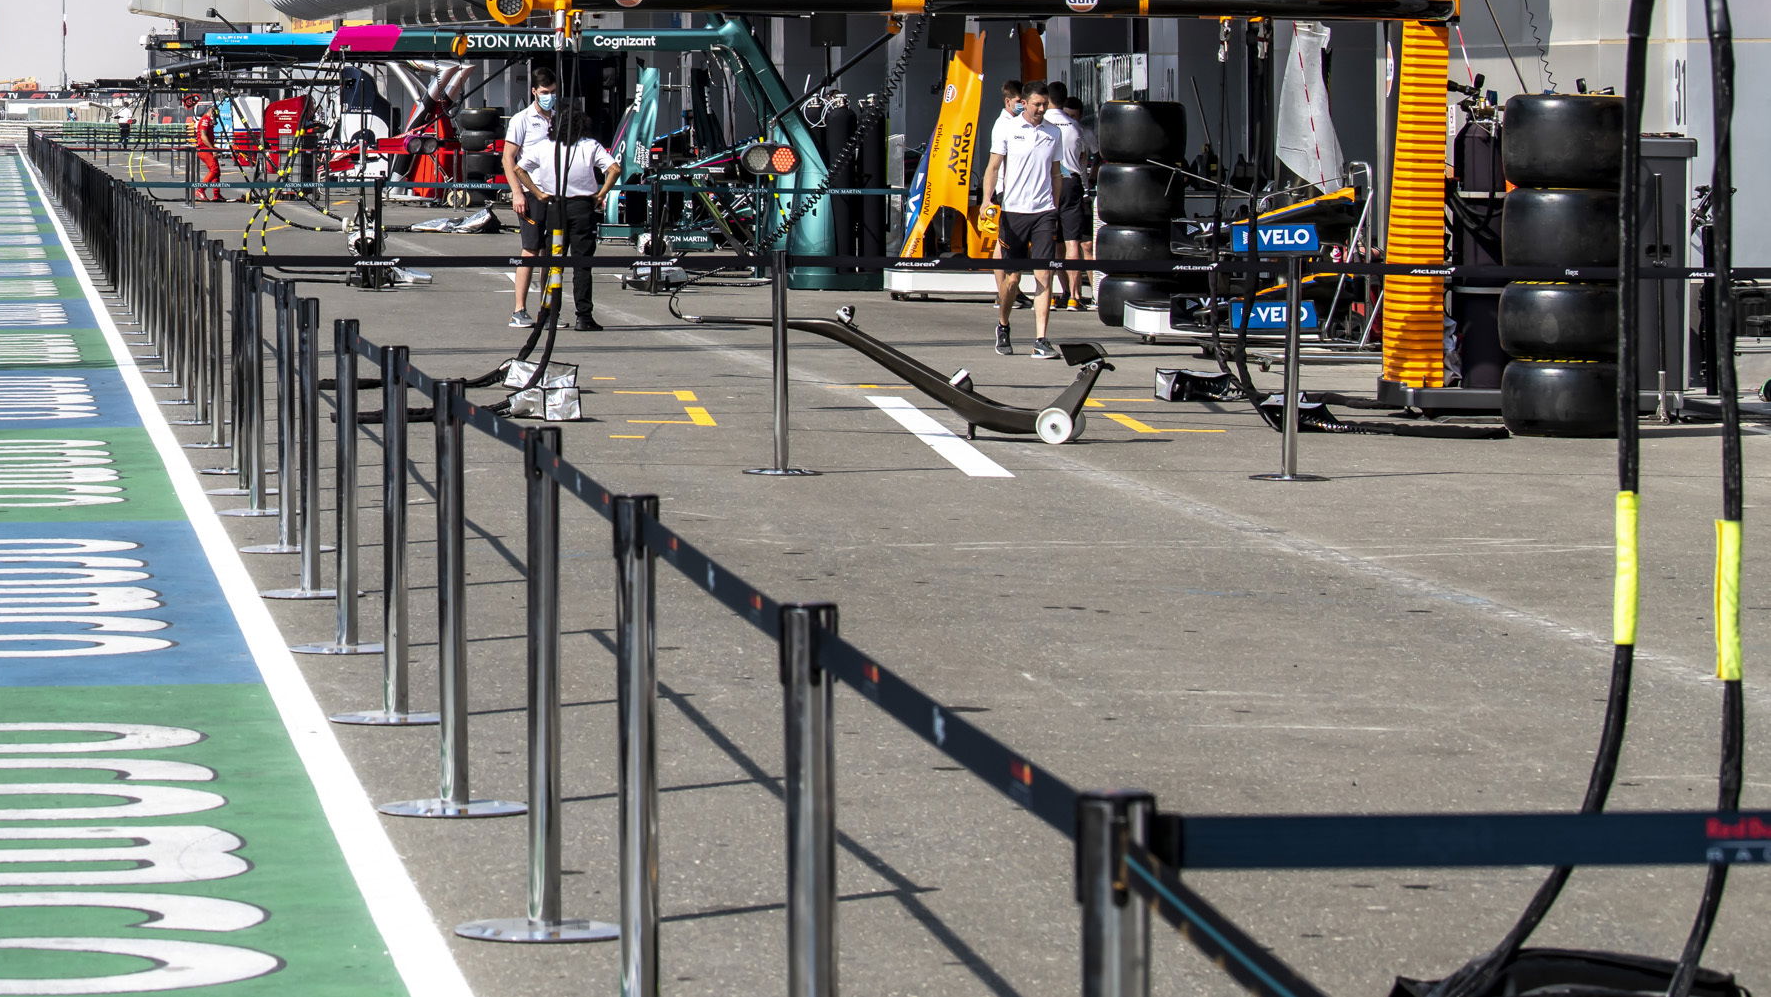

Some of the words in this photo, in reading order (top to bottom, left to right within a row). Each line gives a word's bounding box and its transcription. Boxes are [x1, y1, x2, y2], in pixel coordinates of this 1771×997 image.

[466, 34, 510, 49] STON
[593, 35, 656, 50] Cognizant
[1675, 59, 1686, 125] 31
[947, 134, 962, 174] PAY
[1258, 228, 1310, 245] VELO
